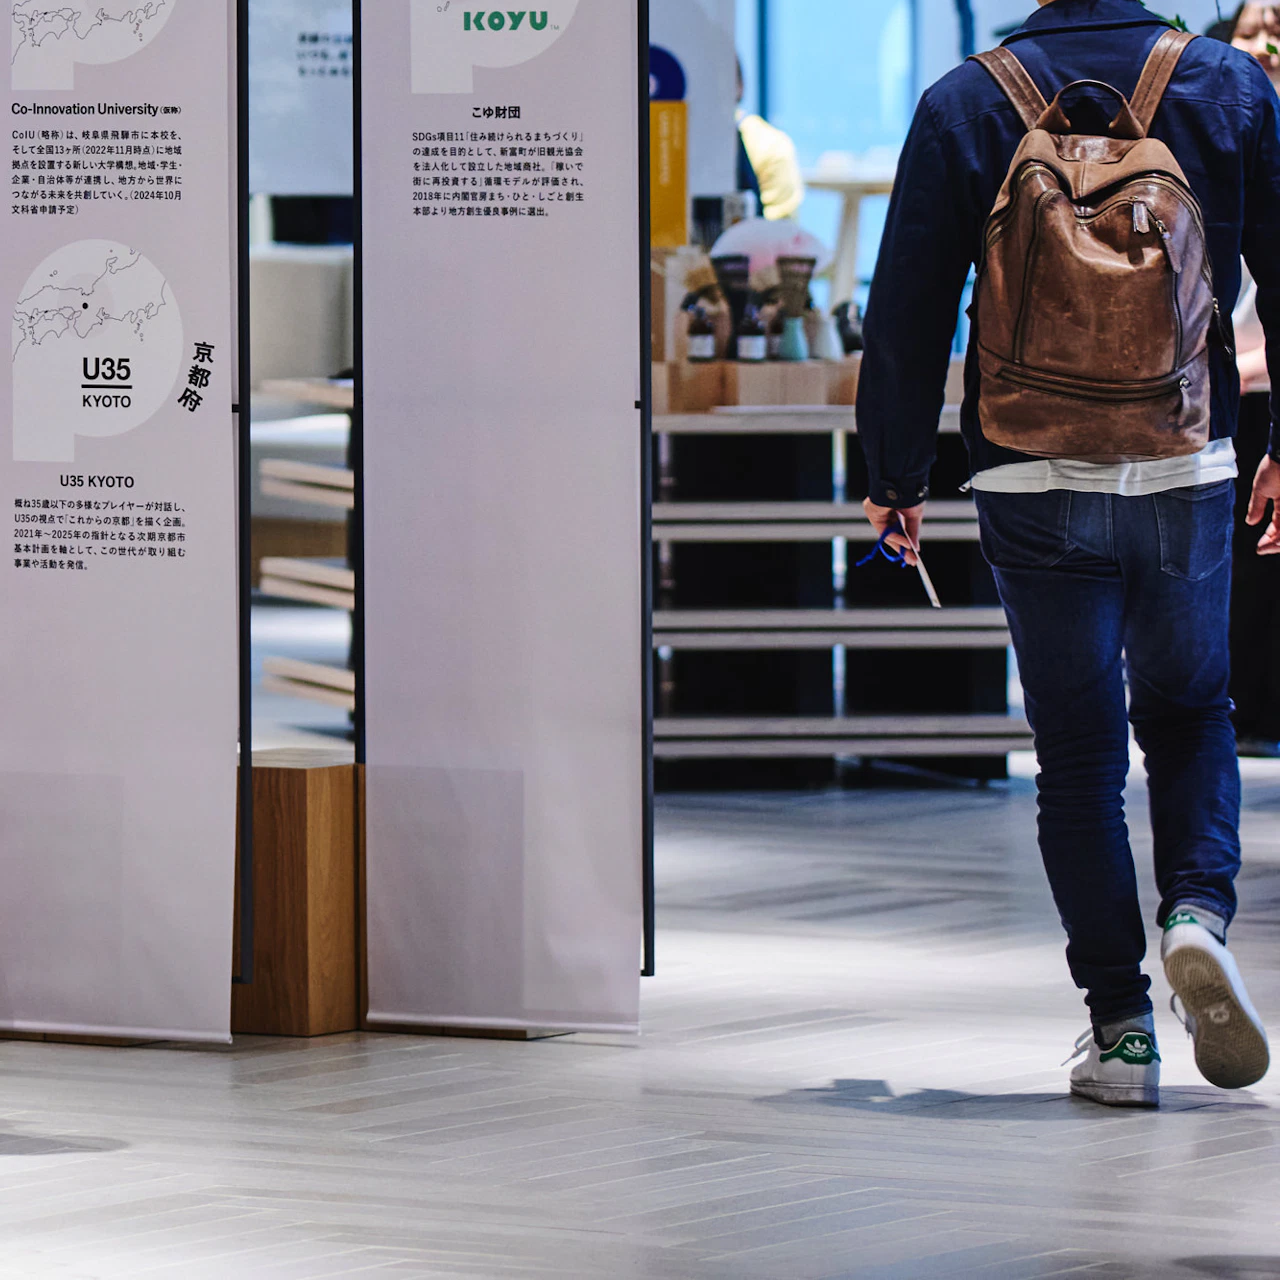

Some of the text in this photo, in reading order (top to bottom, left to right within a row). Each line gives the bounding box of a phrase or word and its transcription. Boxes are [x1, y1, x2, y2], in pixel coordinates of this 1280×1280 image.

[463, 11, 548, 31] KOYU
[11, 102, 95, 115] Co-Innovation
[472, 106, 521, 119] こゆ財団
[82, 356, 131, 381] U35
[177, 340, 215, 413] 京都府
[81, 394, 132, 409] KYOTO
[60, 474, 135, 489] U35 KYOTO
